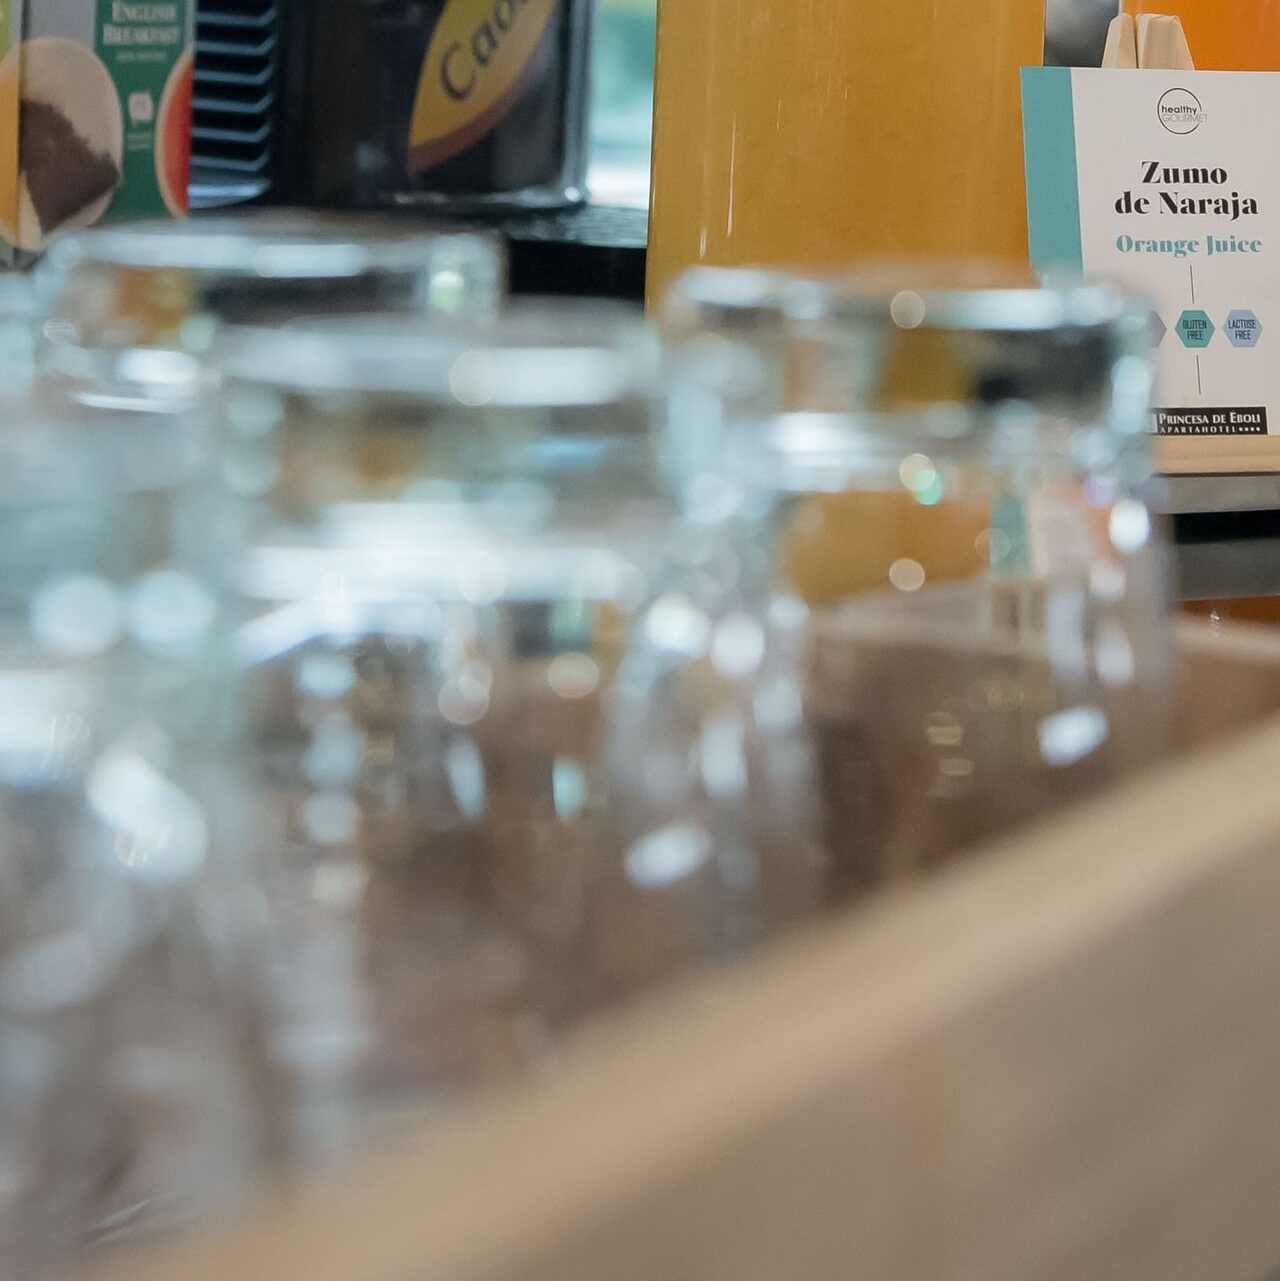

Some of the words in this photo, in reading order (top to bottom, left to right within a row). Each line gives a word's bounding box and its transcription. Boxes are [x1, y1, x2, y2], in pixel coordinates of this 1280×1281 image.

[1161, 105, 1197, 115] healthy
[1162, 113, 1207, 123] GOURMET
[1142, 161, 1227, 184] Zumo
[1115, 191, 1150, 214] de
[1159, 191, 1259, 222] Naraja
[1116, 234, 1199, 258] Orange
[1206, 234, 1262, 256] Juice
[1182, 320, 1207, 329] GLUTEN
[1228, 319, 1256, 329] LACTOSE
[1187, 331, 1203, 340] FREE
[1235, 331, 1252, 340] FREE
[1159, 413, 1209, 424] PRINCESA
[1213, 414, 1226, 423] DE
[1230, 412, 1260, 423] EBOLI
